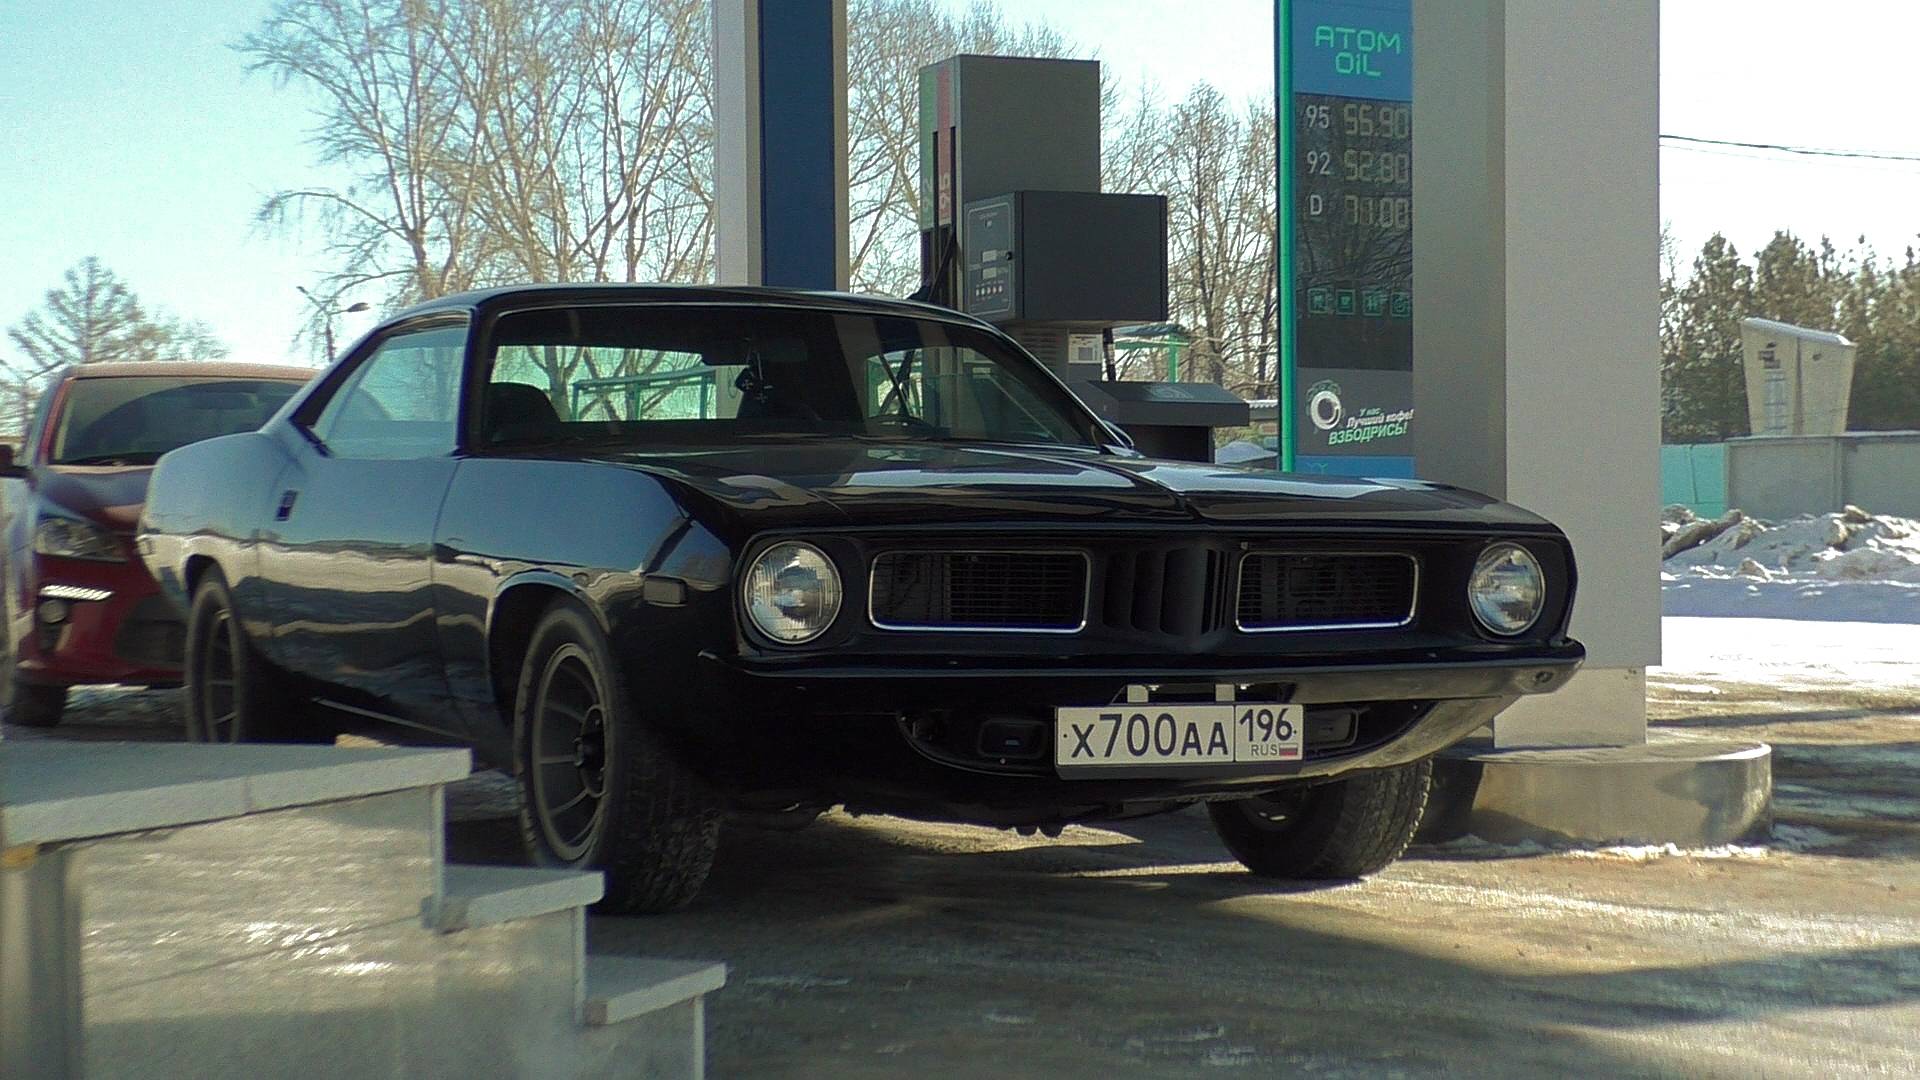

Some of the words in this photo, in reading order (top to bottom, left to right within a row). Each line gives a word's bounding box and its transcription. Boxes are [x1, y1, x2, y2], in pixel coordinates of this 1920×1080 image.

[1314, 26, 1401, 54] ATOM
[1306, 105, 1330, 129] 95
[1343, 103, 1409, 138] 55.90
[1306, 151, 1331, 175] 92
[1310, 194, 1322, 215] D
[1328, 422, 1408, 445] ВЗБОДРИСЬ!
[1239, 708, 1293, 742] 196
[1251, 744, 1278, 757] RUS
